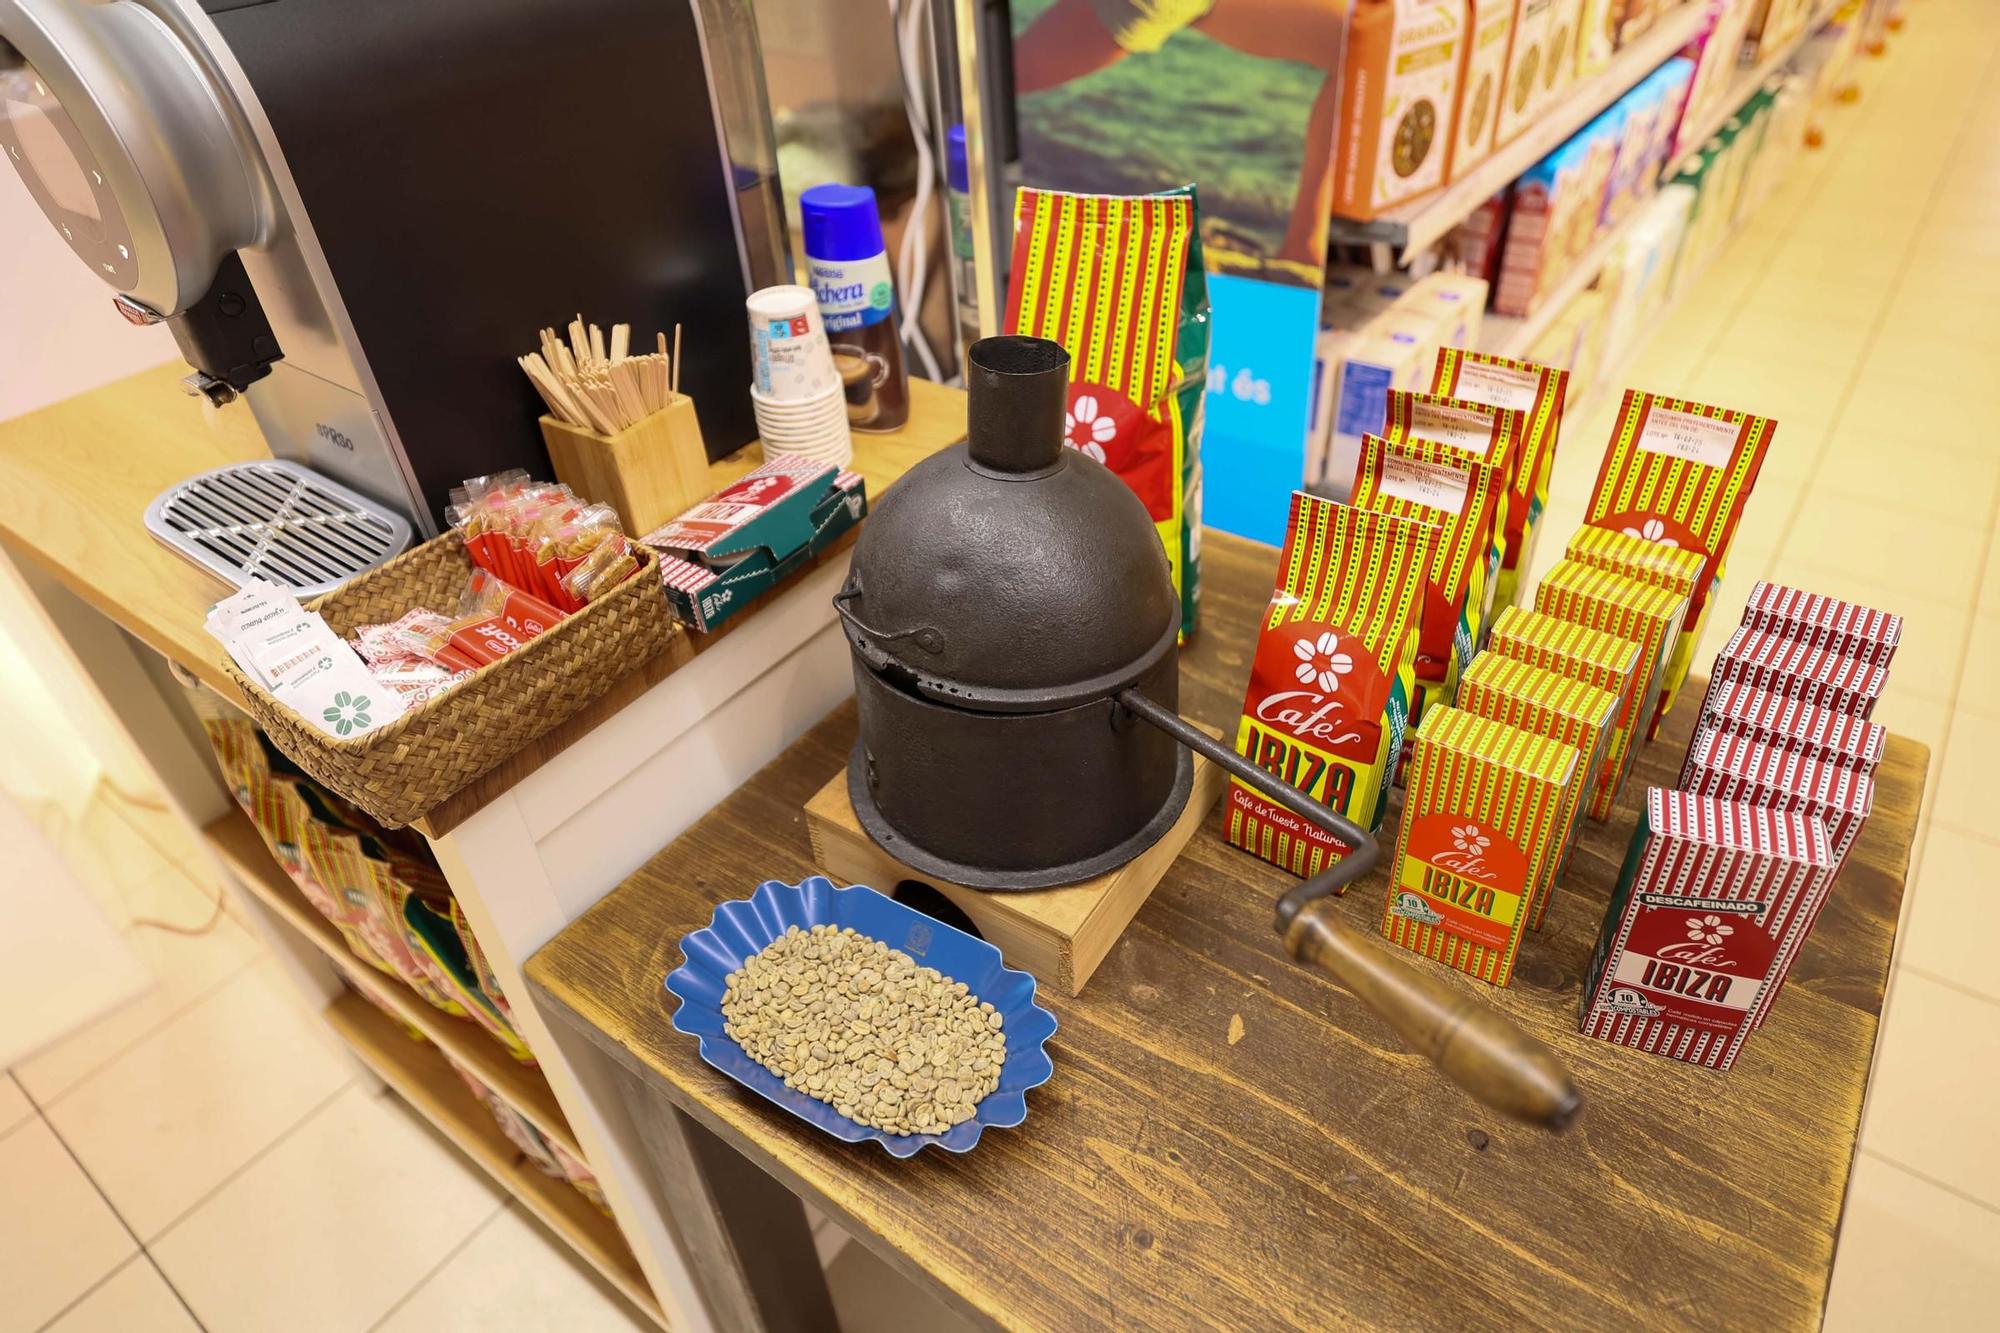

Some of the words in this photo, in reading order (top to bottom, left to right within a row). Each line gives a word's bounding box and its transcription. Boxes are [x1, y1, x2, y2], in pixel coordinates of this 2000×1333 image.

[823, 311, 863, 332] riginal
[474, 623, 522, 650] scoff
[1256, 690, 1361, 745] Cafés
[1244, 724, 1357, 817] IBIZA
[1233, 789, 1254, 810] Café
[1255, 803, 1267, 816] de
[1267, 809, 1300, 832] Tueste
[1303, 823, 1347, 848] Natura
[1431, 851, 1497, 879] Cafés
[1407, 898, 1418, 908] 10
[1421, 865, 1496, 916] IBIZA
[1645, 894, 1758, 912] DESCAFEINADO
[1656, 942, 1737, 967] Cafés
[1640, 958, 1733, 1003] IBIZA
[1620, 994, 1634, 1002] 10
